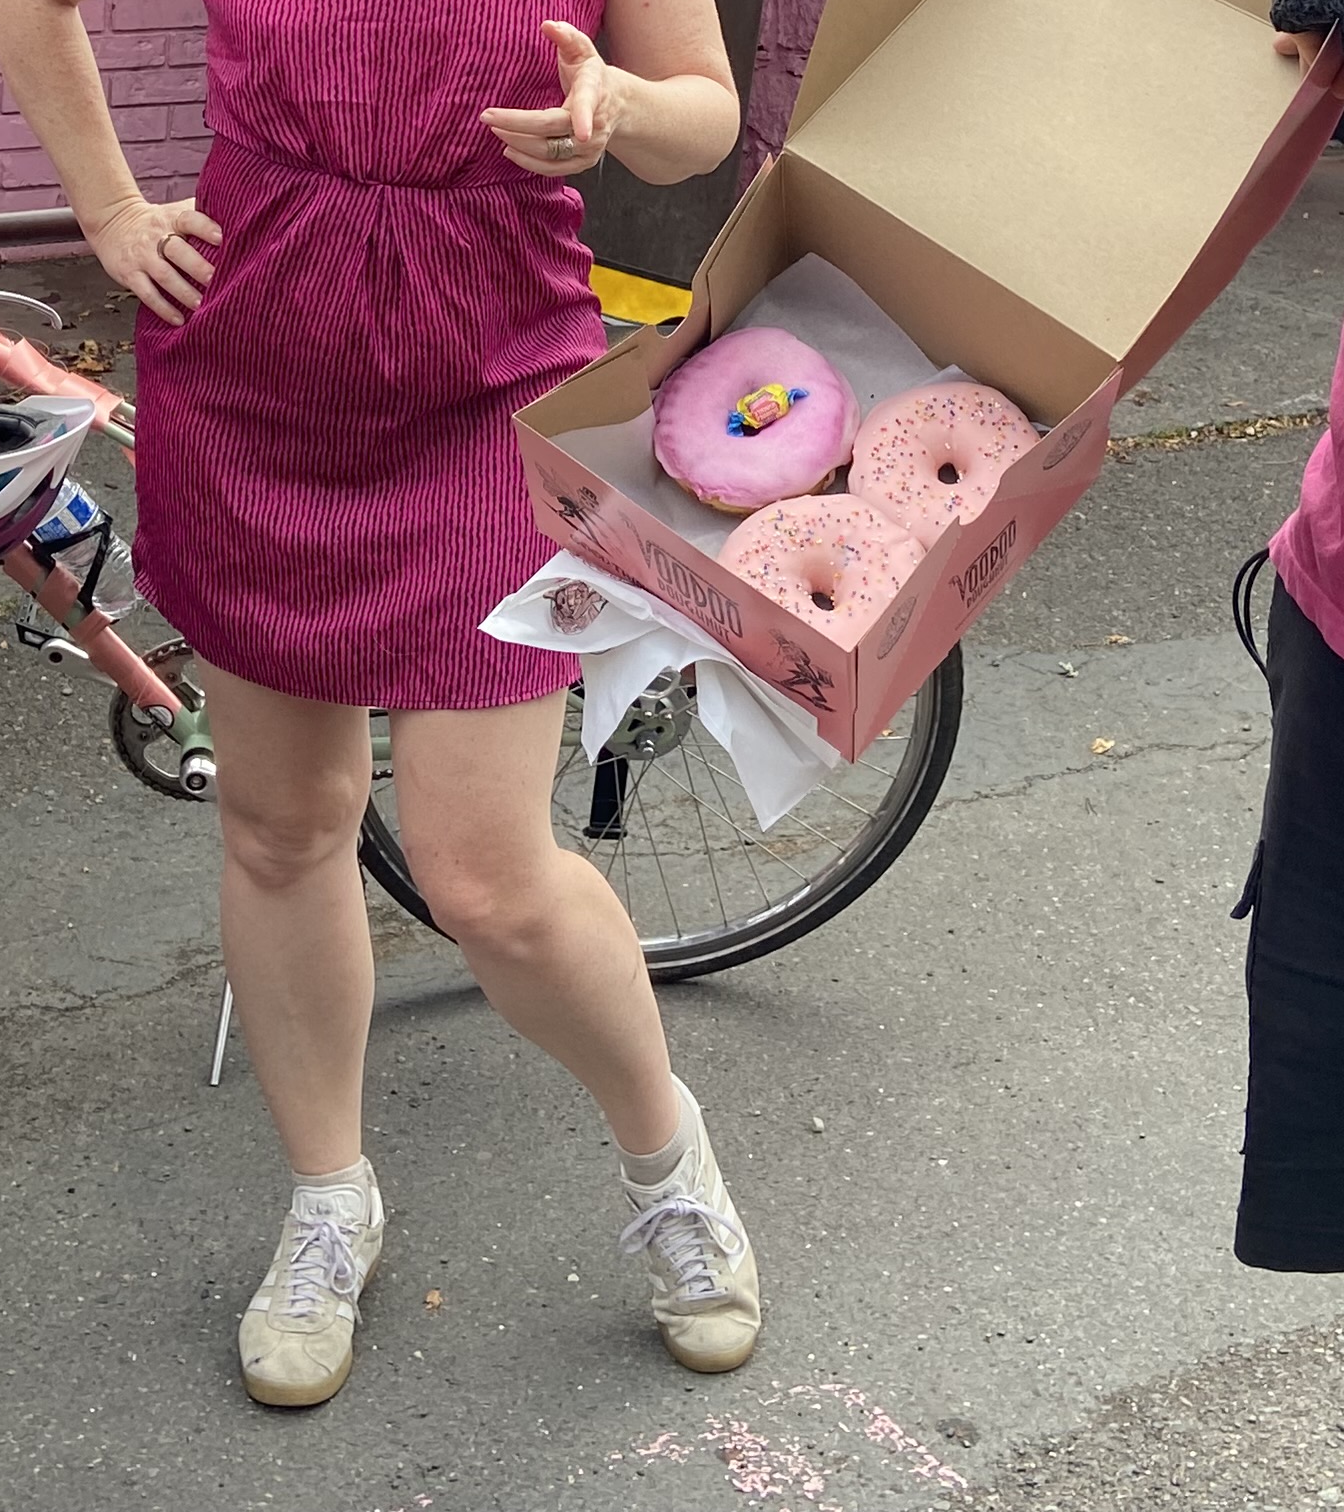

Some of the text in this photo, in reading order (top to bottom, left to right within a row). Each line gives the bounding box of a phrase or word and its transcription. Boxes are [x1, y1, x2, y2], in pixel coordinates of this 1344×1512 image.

[618, 509, 744, 639] VOODOO
[948, 516, 1017, 602] VOODOO
[657, 577, 731, 644] DOUGHNUT
